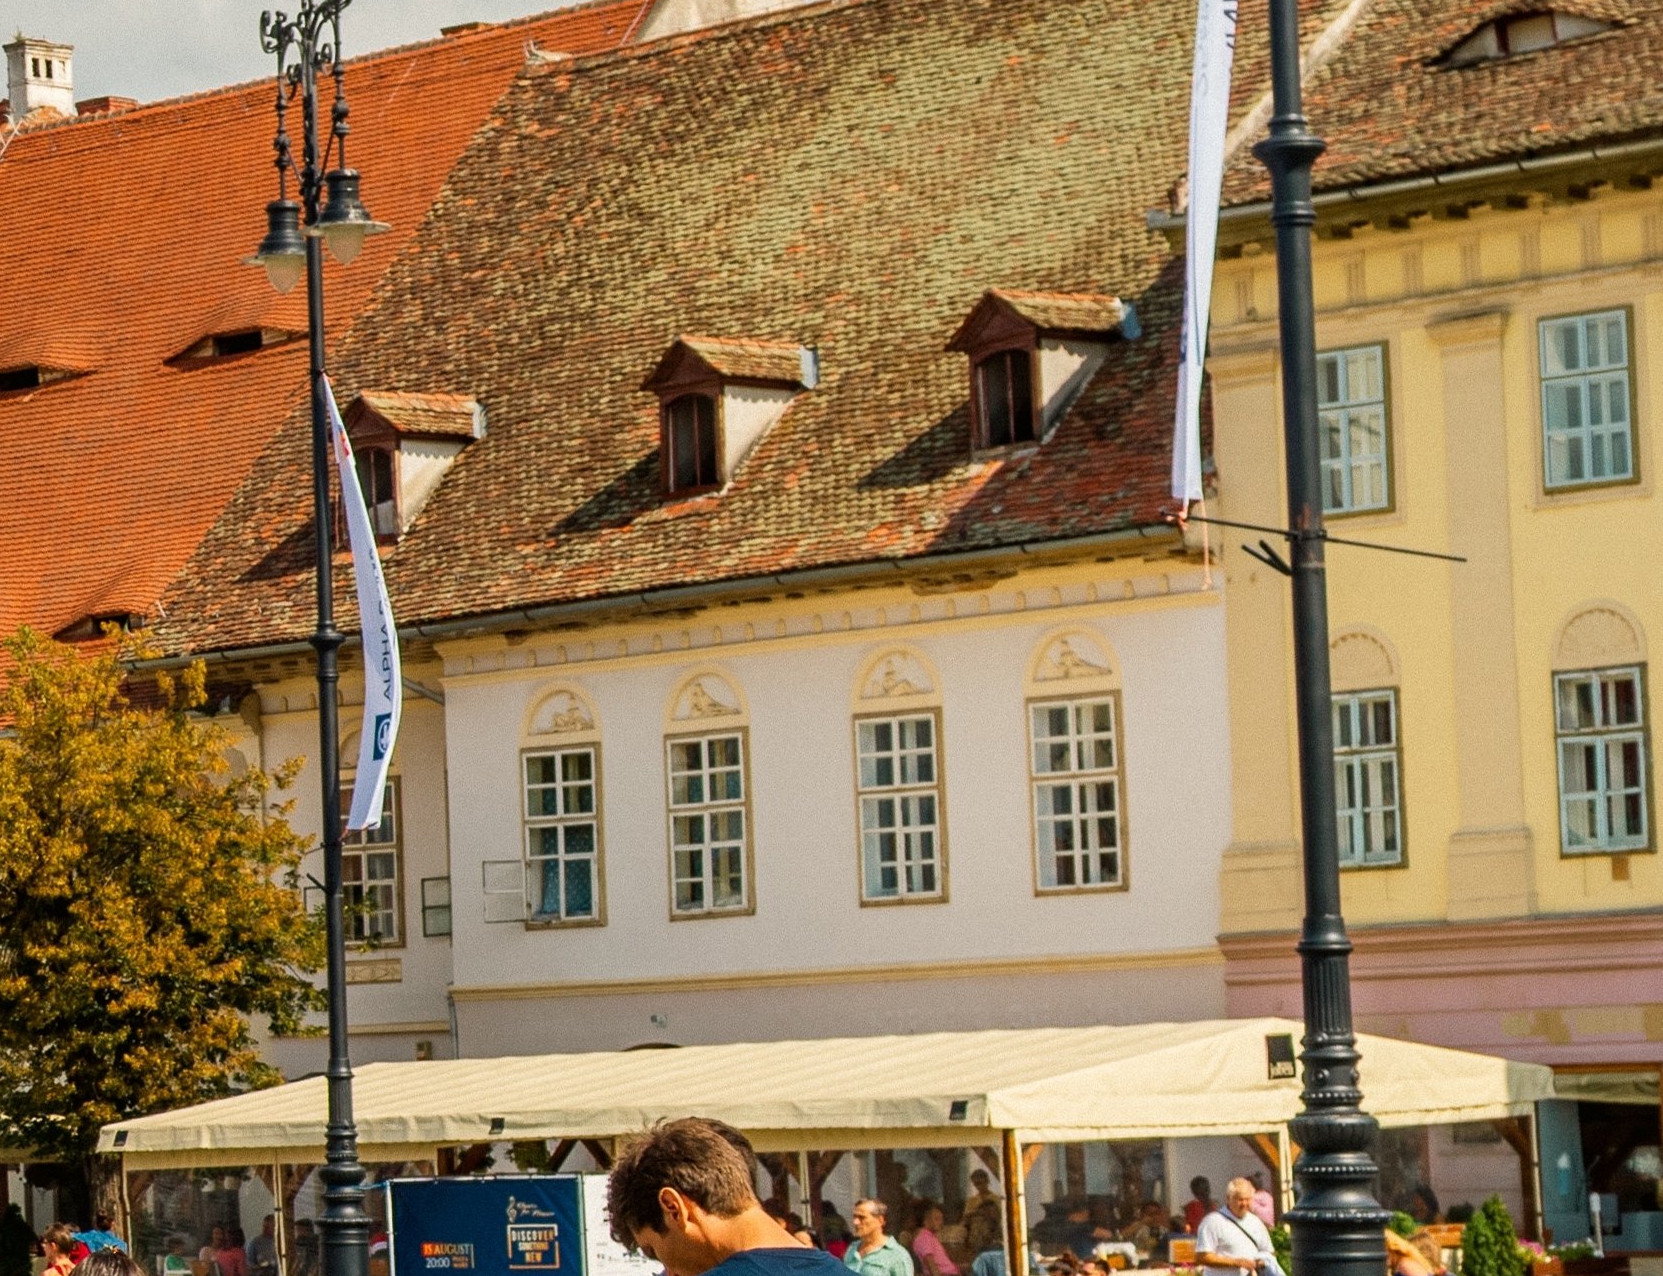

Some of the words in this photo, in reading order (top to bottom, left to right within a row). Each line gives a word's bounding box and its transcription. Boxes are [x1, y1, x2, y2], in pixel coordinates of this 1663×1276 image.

[511, 1230, 555, 1242] DISCOVER
[434, 1243, 470, 1255] AUGUST
[426, 1258, 451, 1268] 20:00
